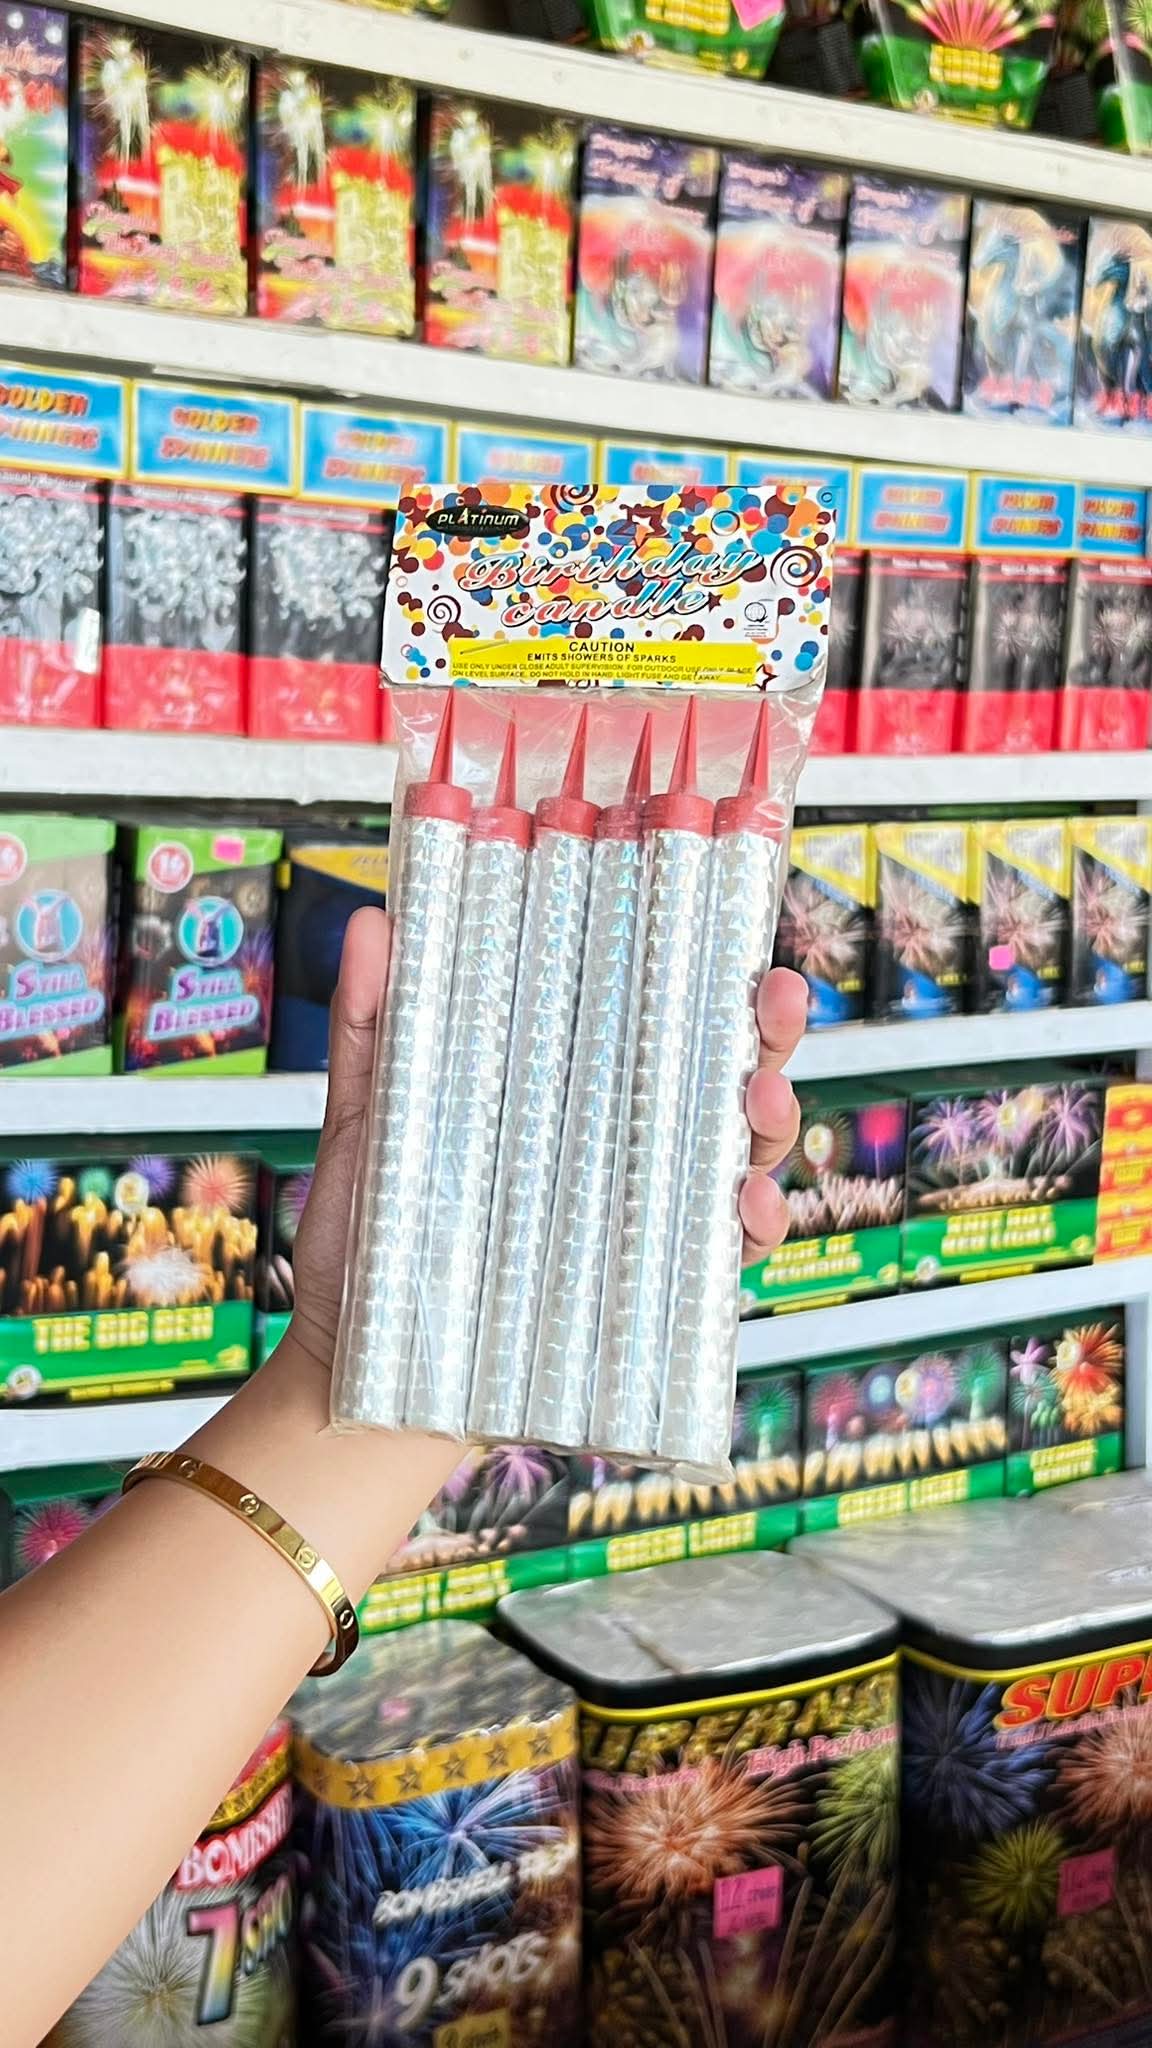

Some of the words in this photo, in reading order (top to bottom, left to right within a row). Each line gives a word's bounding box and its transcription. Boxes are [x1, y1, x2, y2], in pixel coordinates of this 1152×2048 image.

[458, 541, 764, 591] Birthday
[501, 579, 709, 627] candle
[527, 653, 558, 661] EMITS
[561, 653, 613, 661] SHOWERS
[616, 654, 631, 662] OF
[634, 654, 676, 663] SPARKS
[569, 642, 634, 652] CAUTION
[186, 1895, 240, 2027] 7
[395, 1957, 438, 2032] 9
